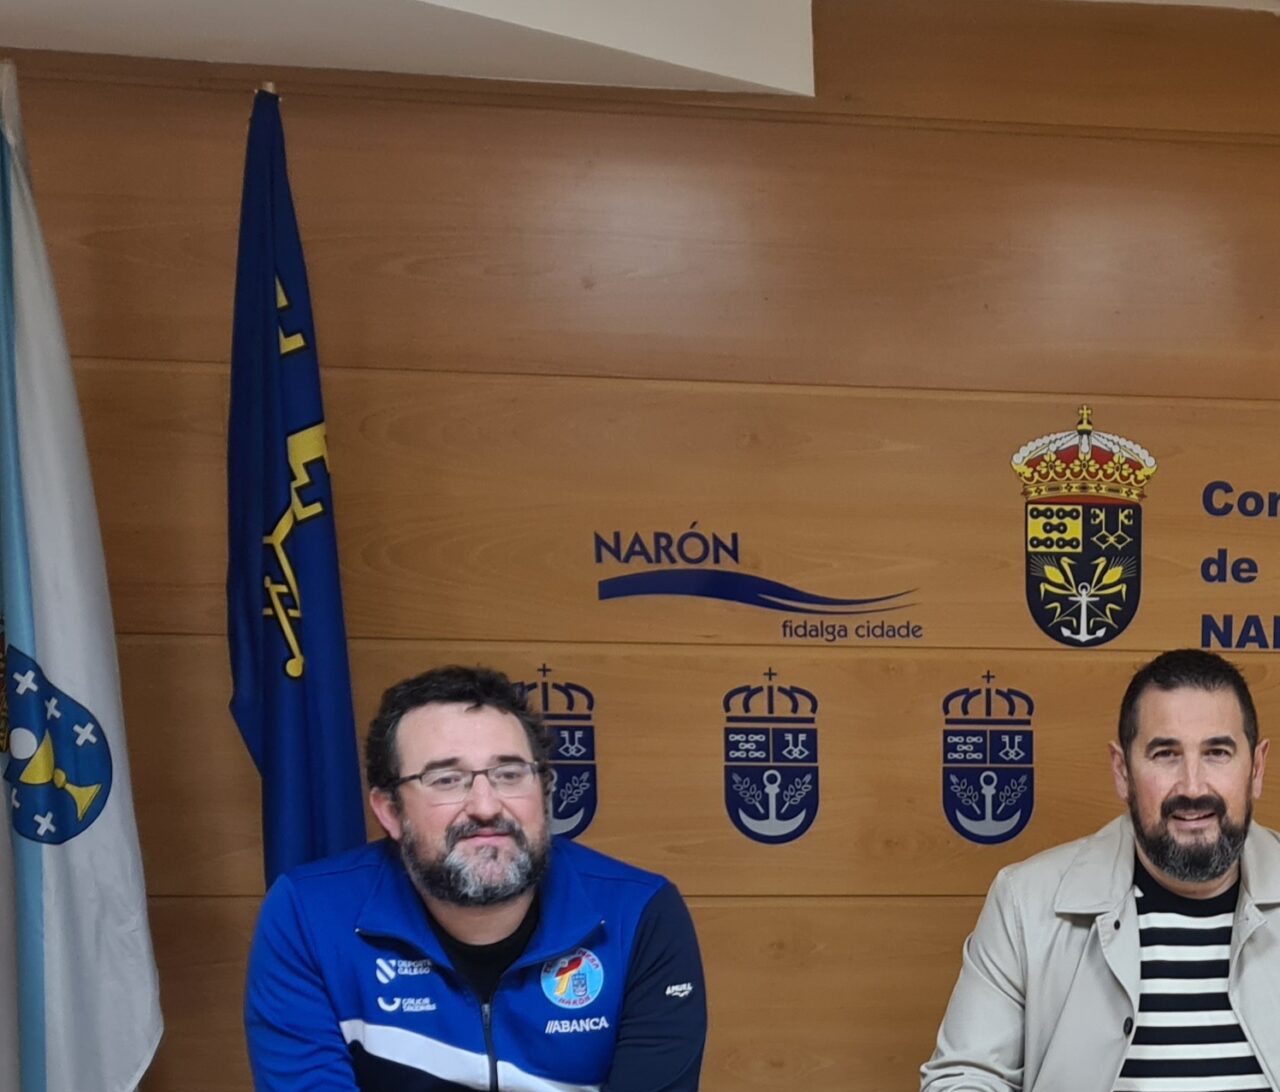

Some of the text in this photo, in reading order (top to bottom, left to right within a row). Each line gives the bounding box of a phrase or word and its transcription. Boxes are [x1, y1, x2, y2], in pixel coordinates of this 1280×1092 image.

[594, 522, 739, 565] NARÓN
[1200, 550, 1258, 584] de
[781, 619, 923, 643] fidalga cidade
[546, 1016, 609, 1034] ABANCA
